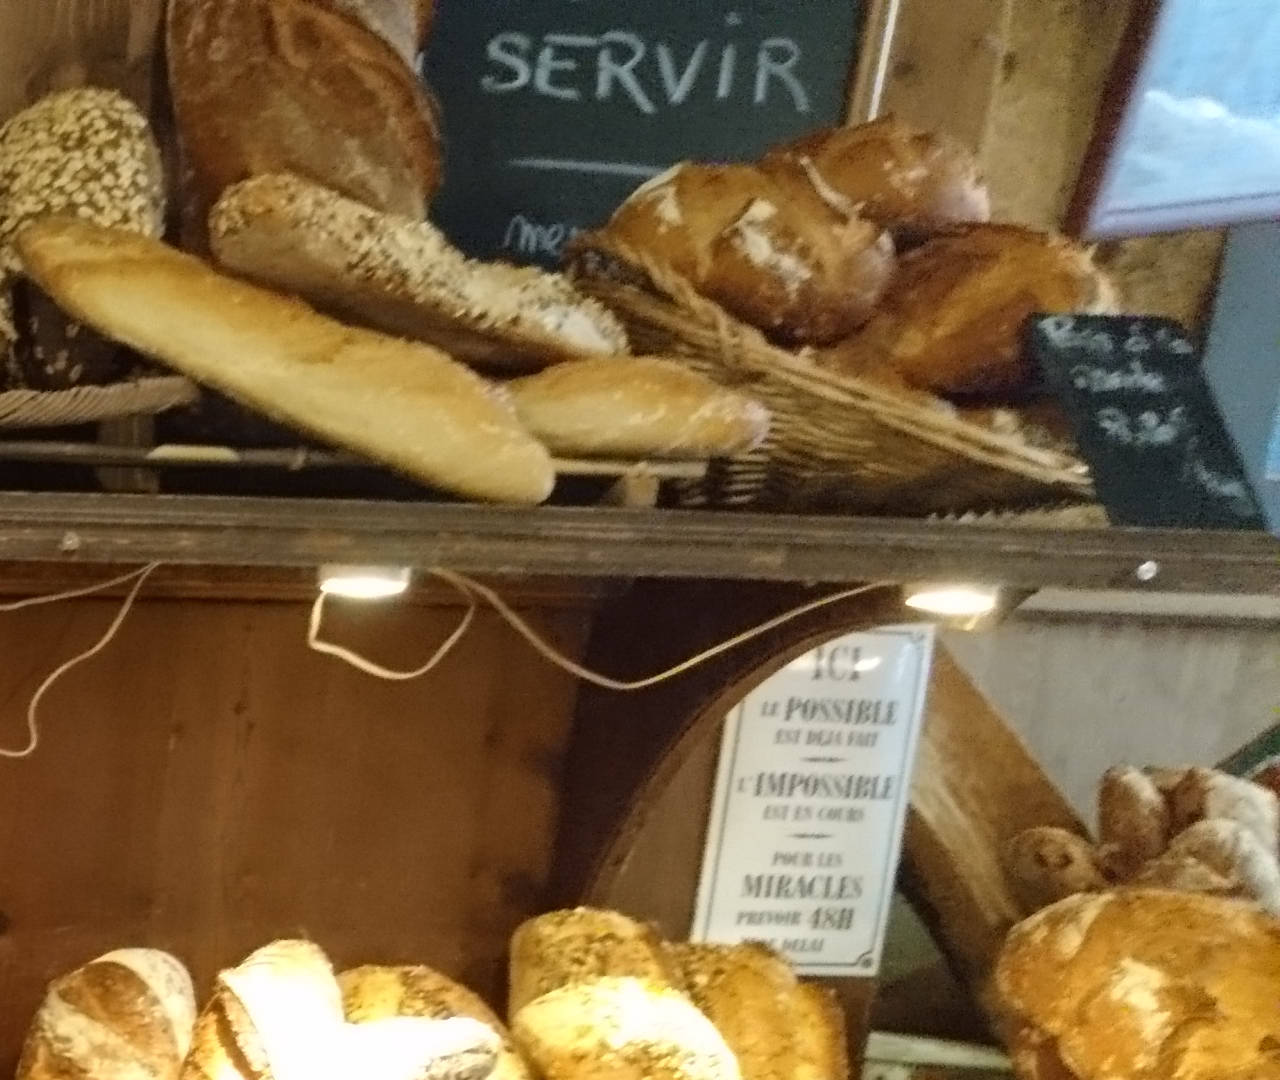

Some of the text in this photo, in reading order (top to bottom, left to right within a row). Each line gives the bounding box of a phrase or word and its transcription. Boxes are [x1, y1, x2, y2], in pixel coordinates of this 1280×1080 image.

[783, 696, 899, 726] POSSIBLE
[771, 851, 814, 867] POUR
[741, 873, 864, 900] MIRACLES
[806, 905, 854, 931] 48H
